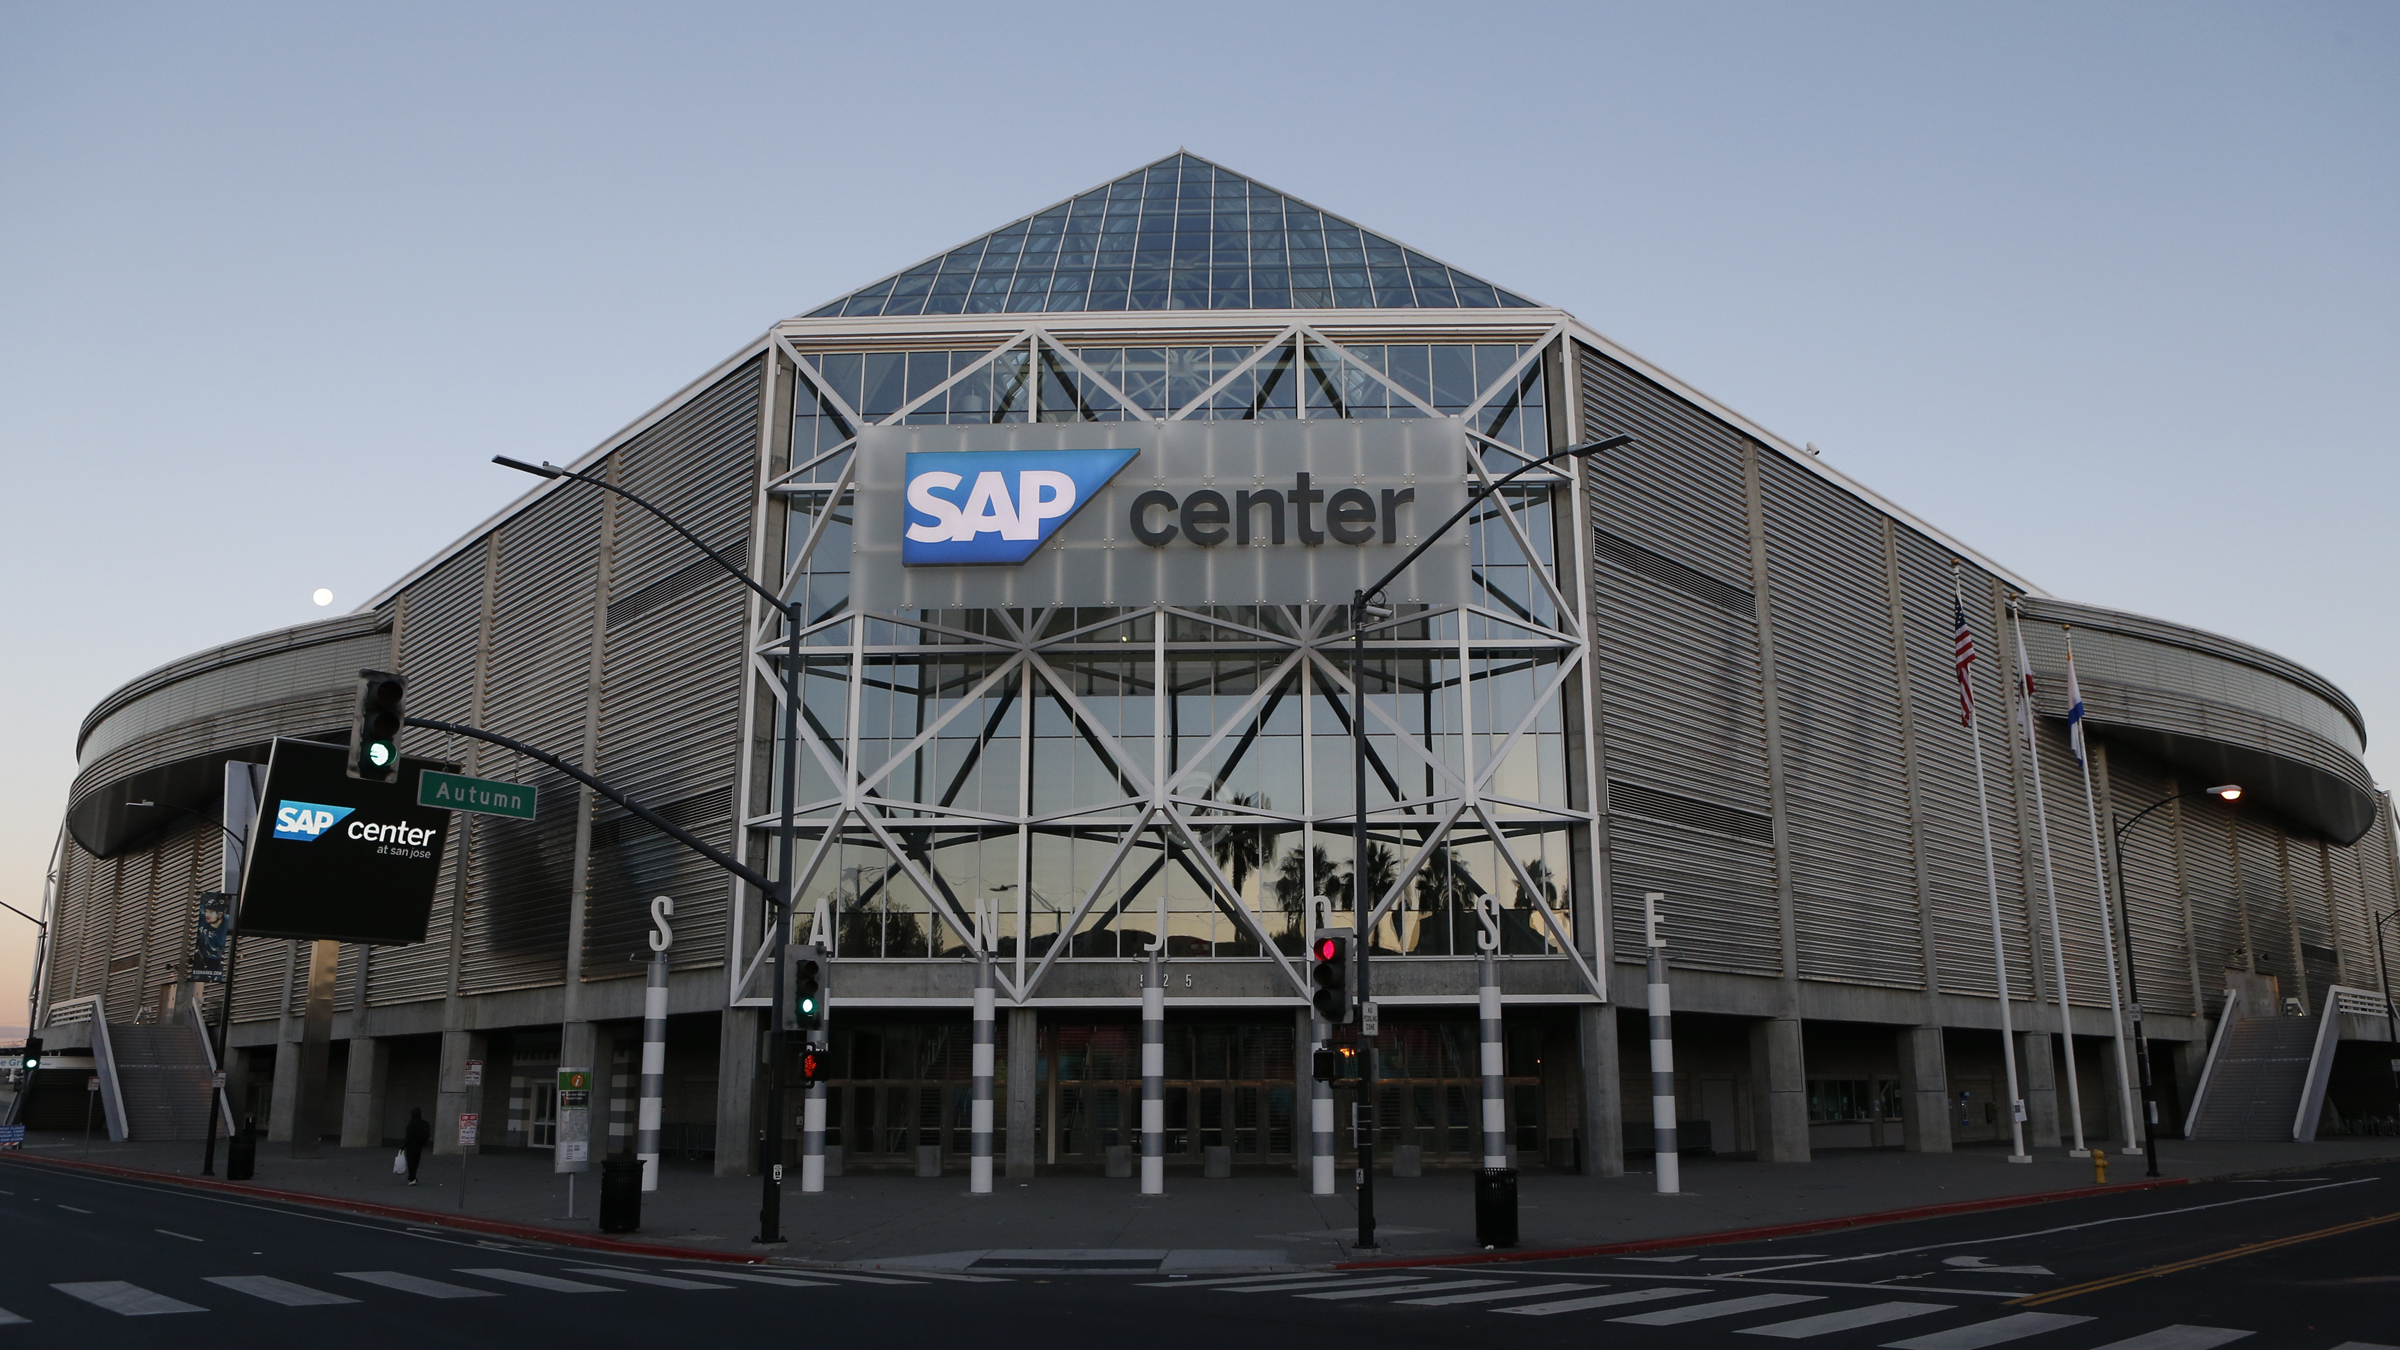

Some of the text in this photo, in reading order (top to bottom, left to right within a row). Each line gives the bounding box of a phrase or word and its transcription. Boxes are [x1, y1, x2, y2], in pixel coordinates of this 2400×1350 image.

[905, 470, 1415, 547] SAP center
[436, 782, 521, 809] Autumn
[275, 807, 437, 847] SAP center
[376, 844, 431, 859] at san jose
